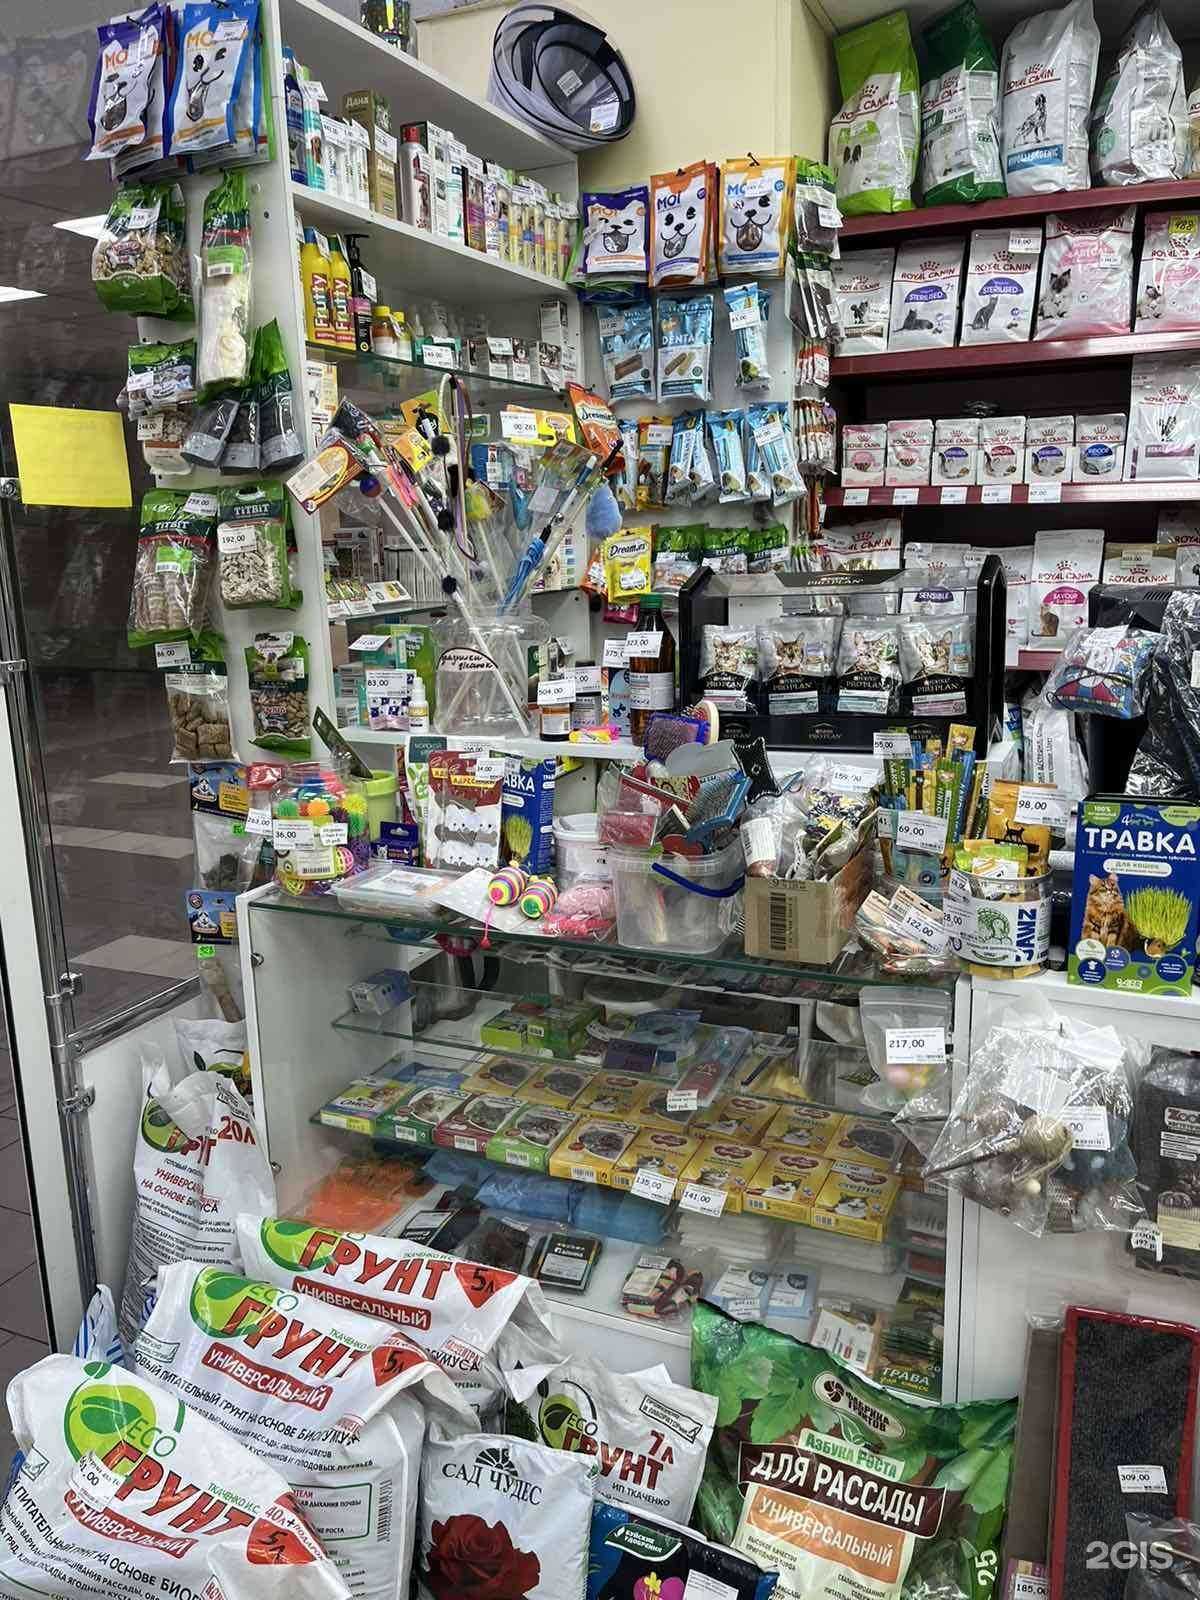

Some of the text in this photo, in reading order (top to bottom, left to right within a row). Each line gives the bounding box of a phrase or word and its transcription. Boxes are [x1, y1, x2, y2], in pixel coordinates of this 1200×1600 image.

[656, 194, 681, 212] MOI
[901, 267, 956, 280] ROYAL CANIN
[975, 262, 1032, 273] ROYAL CANIN
[1174, 535, 1200, 545] ROYA
[1018, 800, 1047, 811] 98,00
[1084, 827, 1196, 855] ТРАВКА
[889, 1039, 925, 1049] 217,00
[298, 1230, 454, 1300] ГРУНТ
[249, 1282, 299, 1312] ECO
[296, 1282, 428, 1328] УНИВЕРСАЛЬНЫЙ
[206, 1349, 328, 1410] УНИВЕРСАЛЬНЫЙ
[125, 1416, 177, 1458] ECO
[257, 1414, 297, 1438] ОСНОВЕ
[566, 1411, 599, 1437] ECO
[561, 1427, 665, 1491] ГРУНТ
[100, 1439, 256, 1537] ГРУНТ
[441, 1462, 544, 1506] САД ЧУДЕС
[611, 1481, 671, 1507] ИП ТКАЧЕНКО
[750, 1451, 926, 1527] ДЛЯ РАССАДЫ
[760, 1495, 895, 1569] УНИВЕРСАЛЬНЫЙ
[109, 1557, 157, 1586] ОСНОВЕ
